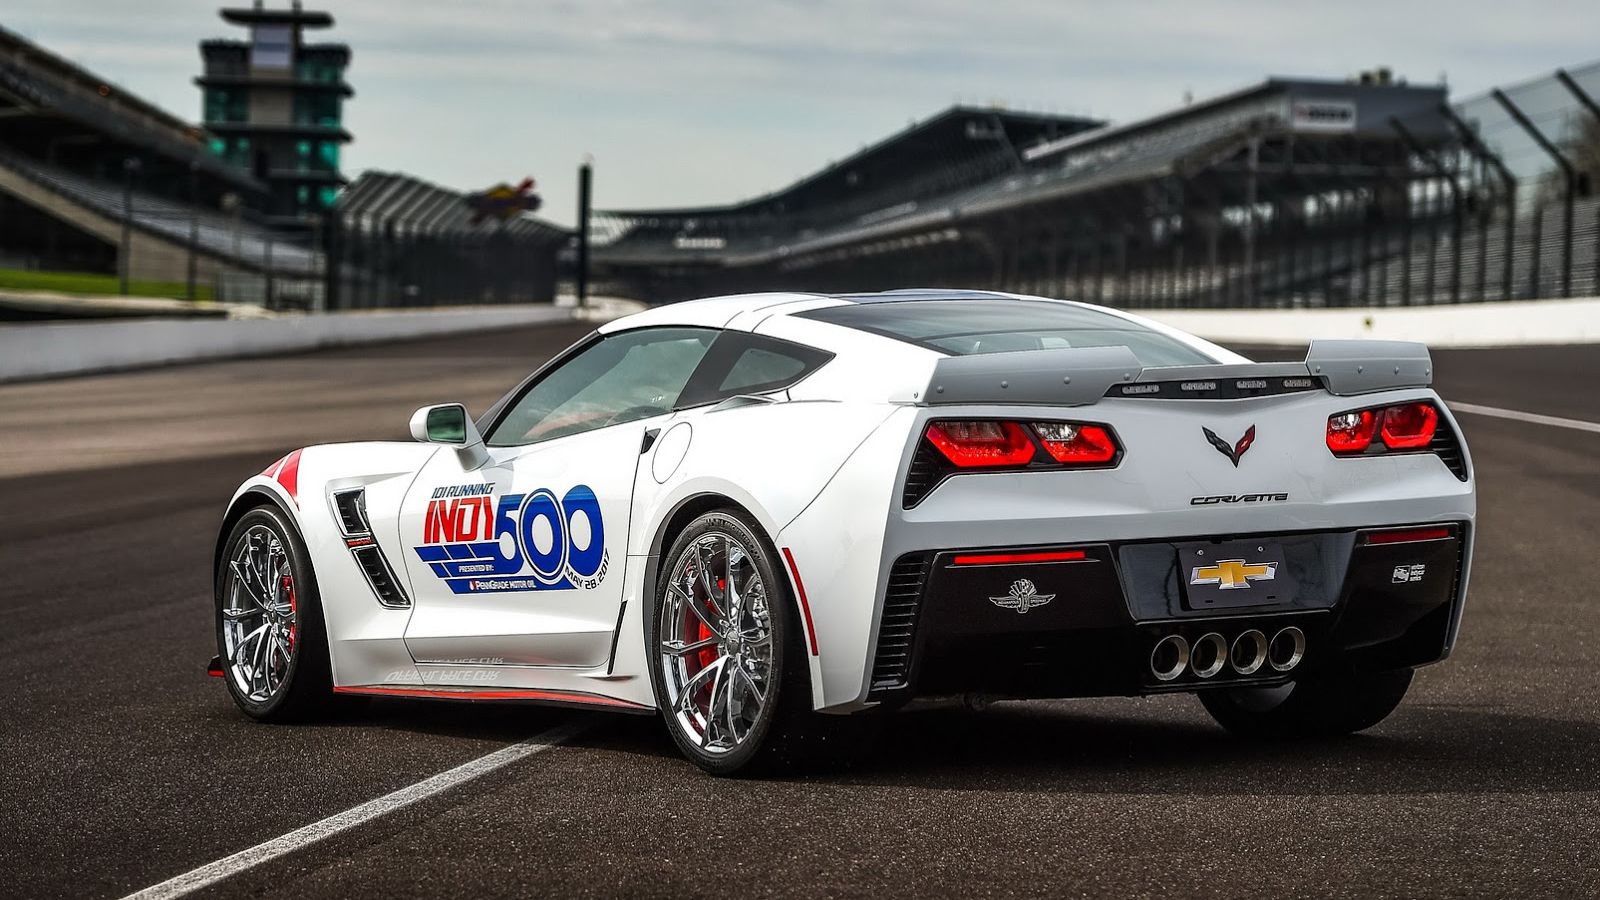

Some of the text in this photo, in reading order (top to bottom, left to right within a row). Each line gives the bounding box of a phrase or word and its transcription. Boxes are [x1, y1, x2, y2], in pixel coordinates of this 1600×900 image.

[447, 482, 495, 497] RUNNING
[1190, 492, 1289, 505] CORVETTE
[424, 484, 605, 581] INDY 500
[565, 564, 583, 588] MAY
